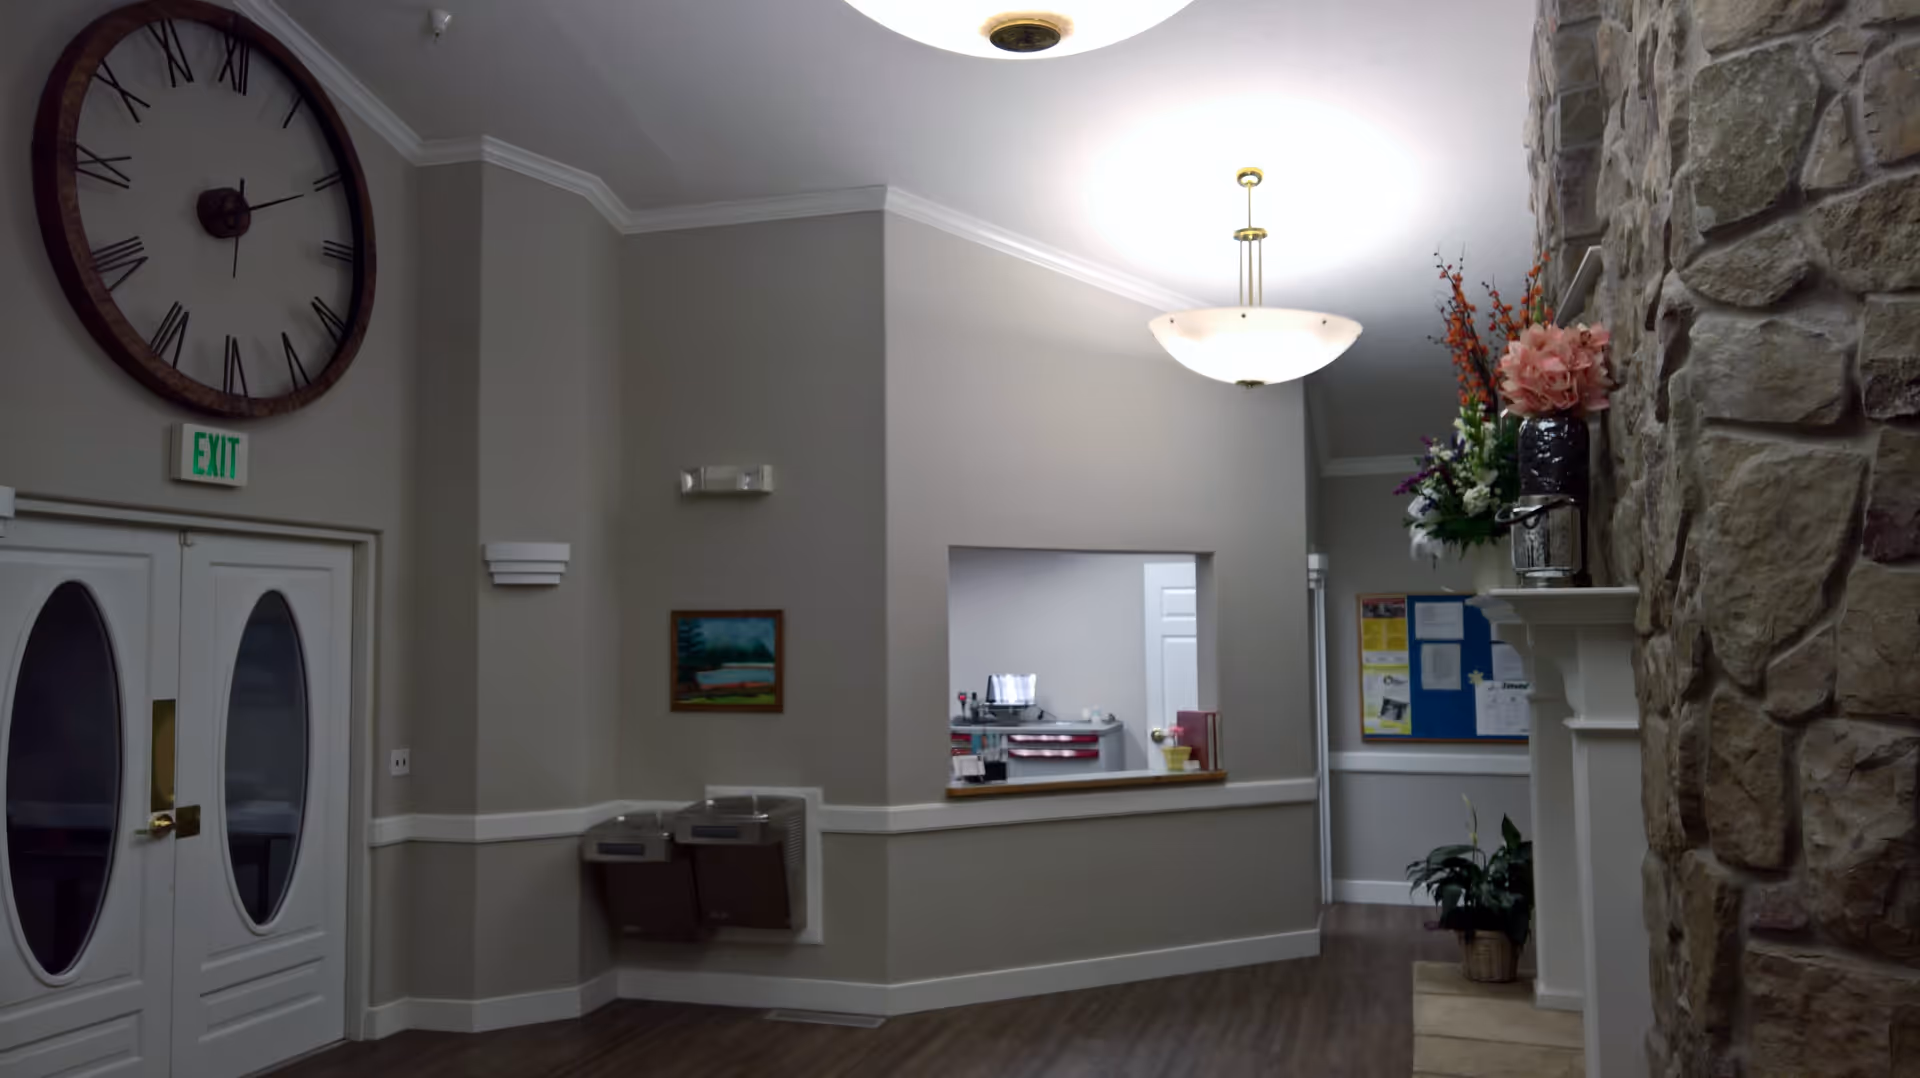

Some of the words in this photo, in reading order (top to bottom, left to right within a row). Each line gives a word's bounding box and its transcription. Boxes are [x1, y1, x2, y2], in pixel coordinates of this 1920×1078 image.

[146, 19, 194, 88] XI
[218, 26, 249, 95] XII
[93, 58, 151, 123] X
[76, 143, 132, 189] IX
[313, 170, 344, 193] II
[92, 236, 149, 292] VIII
[323, 240, 355, 263] III
[149, 301, 189, 370] VII
[311, 296, 346, 346] IV
[224, 335, 248, 397] VI
[193, 432, 240, 479] EXIT
